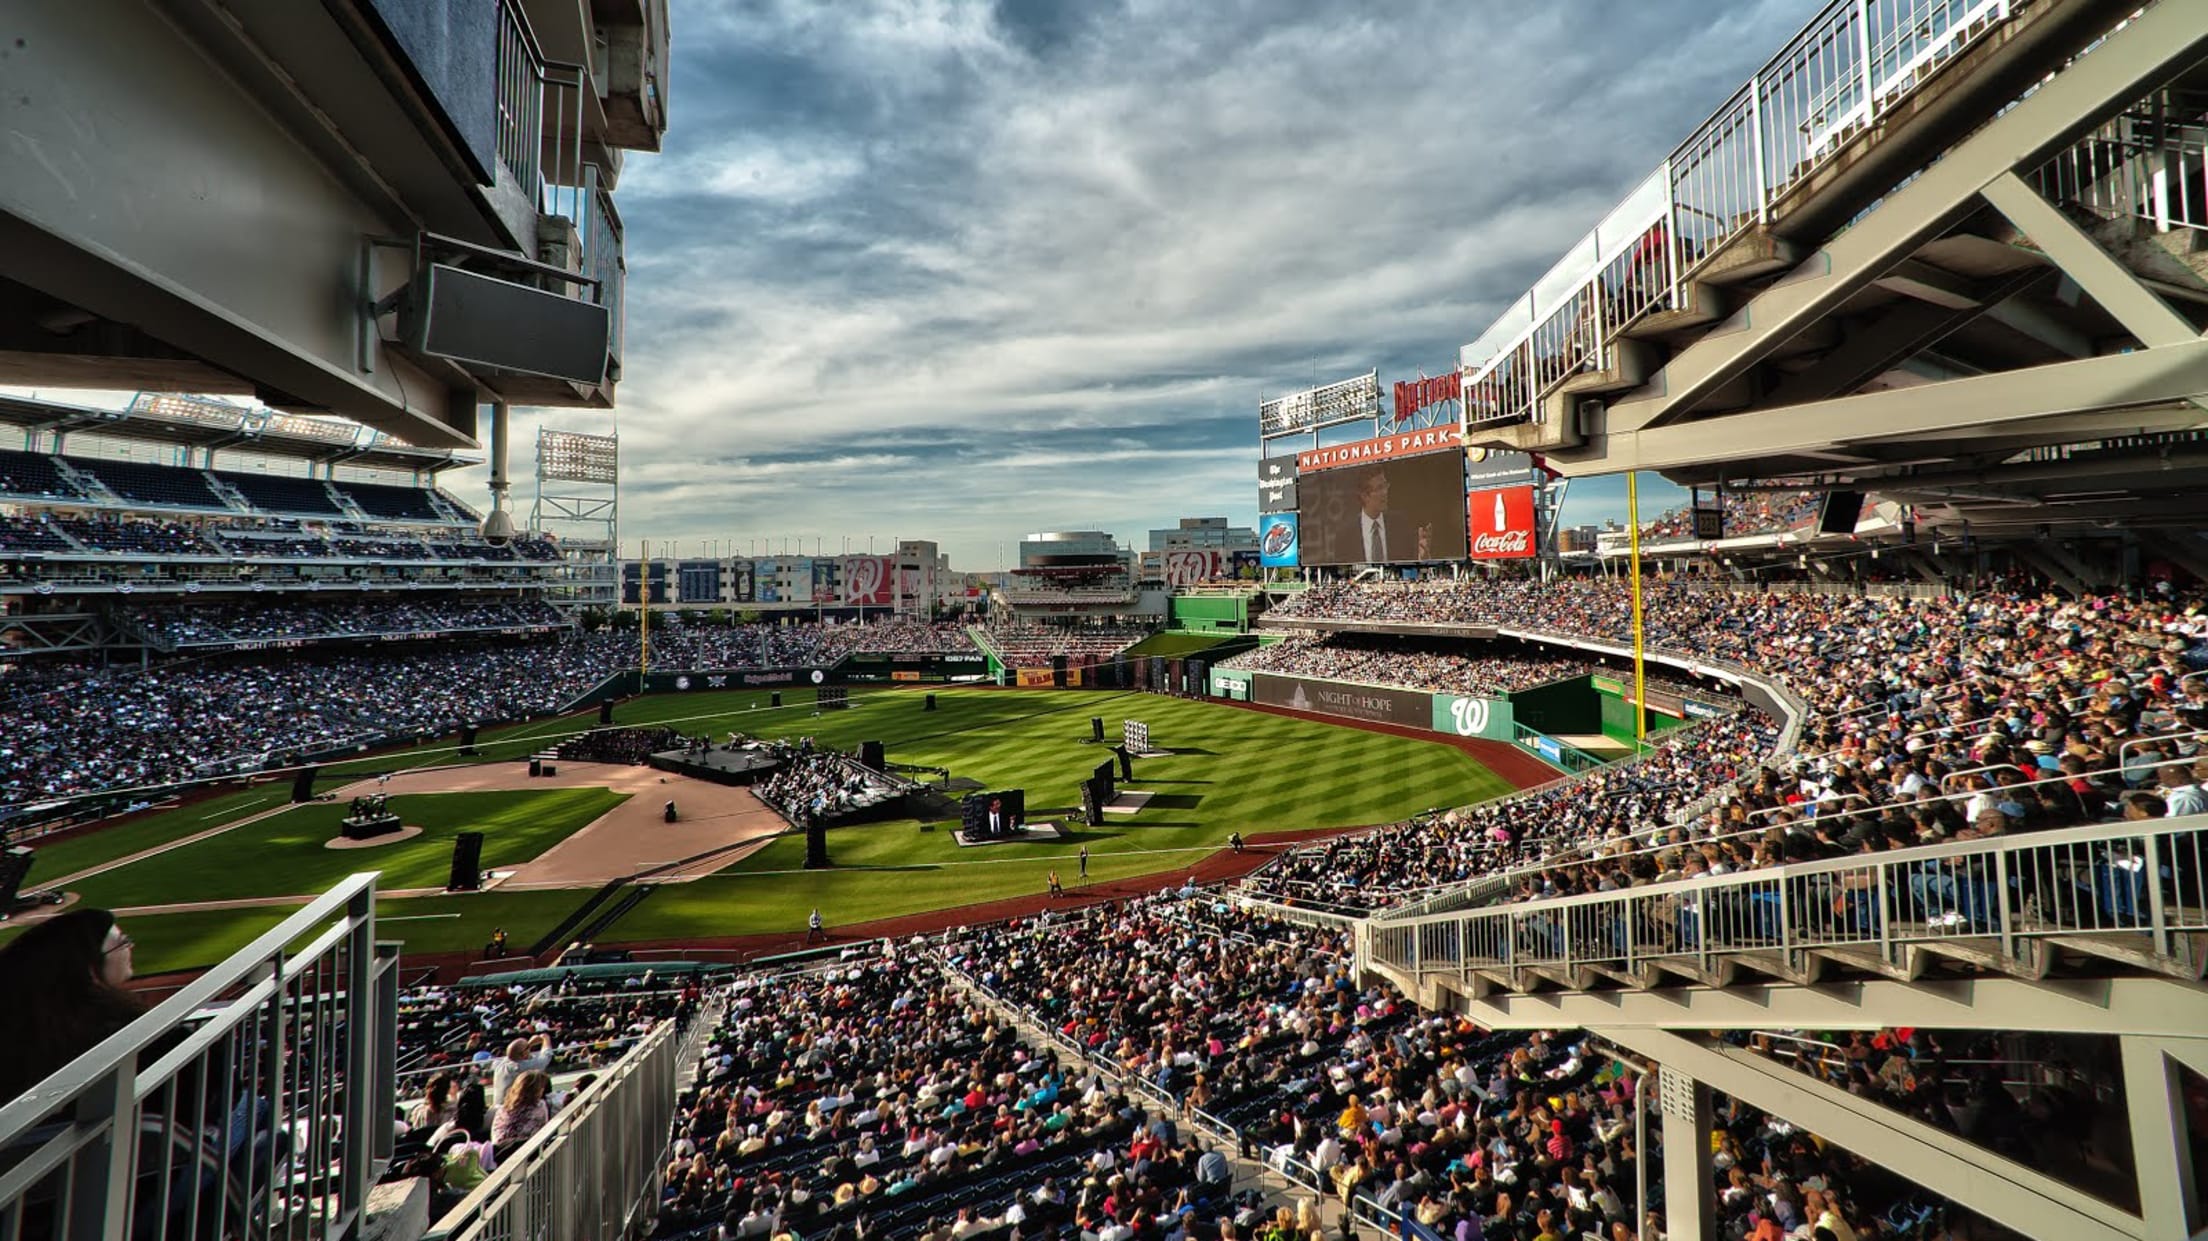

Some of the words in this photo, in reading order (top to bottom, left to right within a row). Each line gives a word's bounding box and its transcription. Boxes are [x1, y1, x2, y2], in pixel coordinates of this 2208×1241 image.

[1394, 371, 1461, 422] NATION
[1302, 440, 1393, 467] NATIONALS
[1401, 430, 1450, 449] PARK
[1474, 530, 1530, 553] Coca-Cola
[1215, 677, 1247, 692] GEICO
[1318, 690, 1352, 706] NIGHT
[1362, 696, 1392, 712] HOPE
